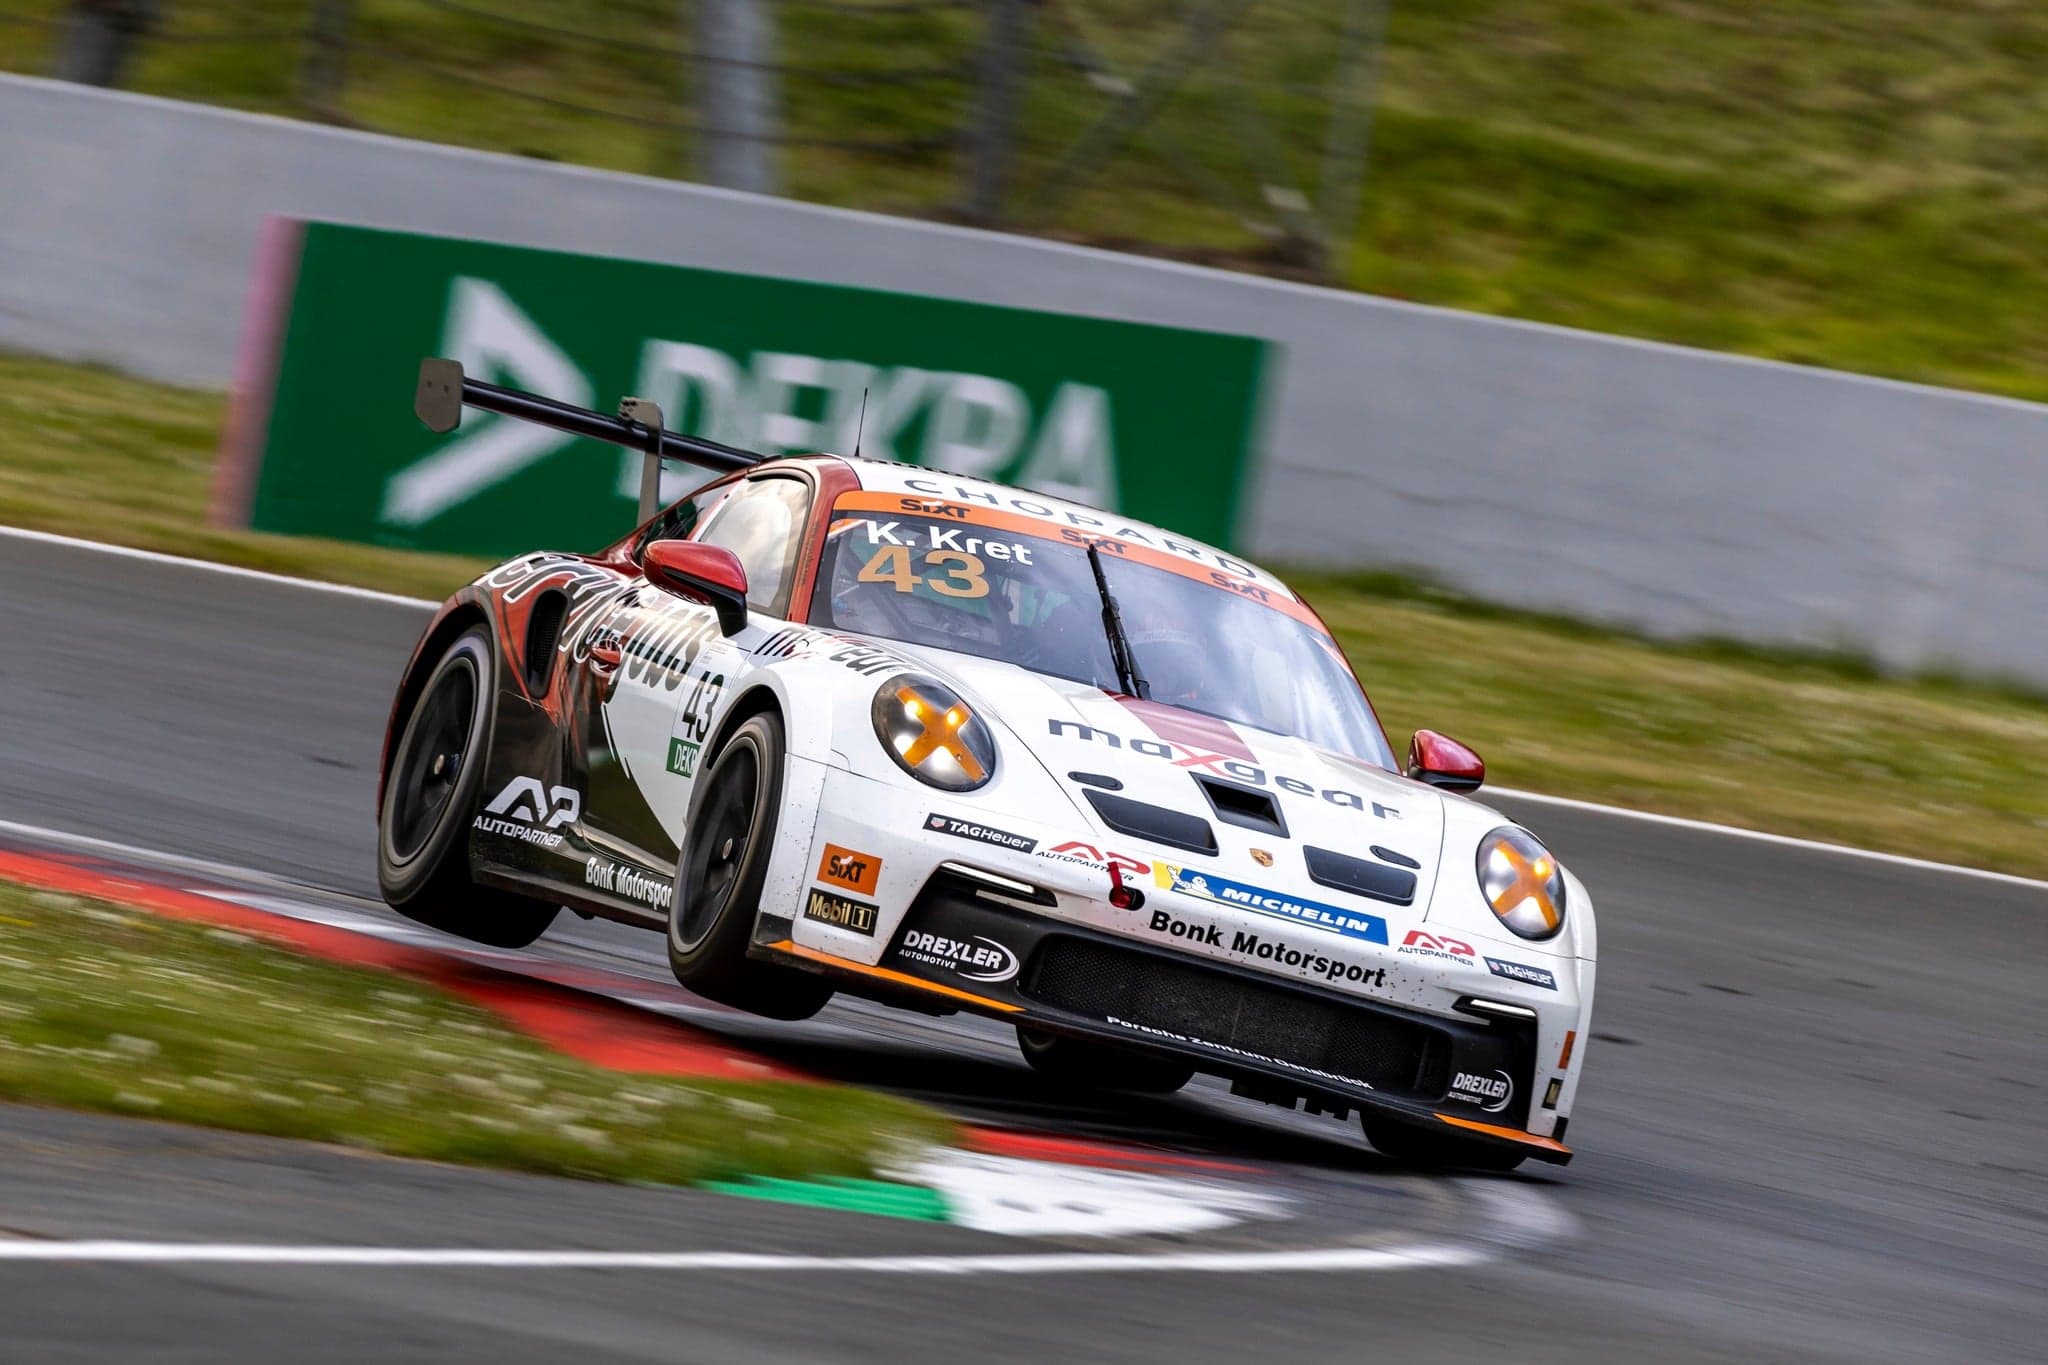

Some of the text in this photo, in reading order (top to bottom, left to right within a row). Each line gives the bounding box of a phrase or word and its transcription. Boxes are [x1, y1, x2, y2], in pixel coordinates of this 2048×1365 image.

[616, 338, 1119, 514] DEKRA
[865, 520, 1033, 566] K. Kret
[904, 479, 1256, 579] CHOPARD
[857, 545, 990, 598] 43
[682, 671, 725, 743] 43
[674, 743, 698, 774] DEKR
[1048, 718, 1402, 820] maxgear
[472, 815, 564, 848] AUTOPARTNER
[585, 857, 672, 910] Bonk Motorspor
[1036, 852, 1134, 881] AUTOPARTR
[809, 893, 851, 925] Mobil
[1222, 887, 1370, 932] MICHELIN
[899, 948, 957, 970] AUTOMOTIVE
[904, 929, 1003, 970] DREXLER
[1149, 910, 1386, 987] Bonk Motorsport
[1397, 946, 1475, 967] AUTOPARTNER
[1106, 1015, 1187, 1041] Porsche
[1188, 1037, 1272, 1063] Zentrum
[1452, 1071, 1508, 1099] DREXLER
